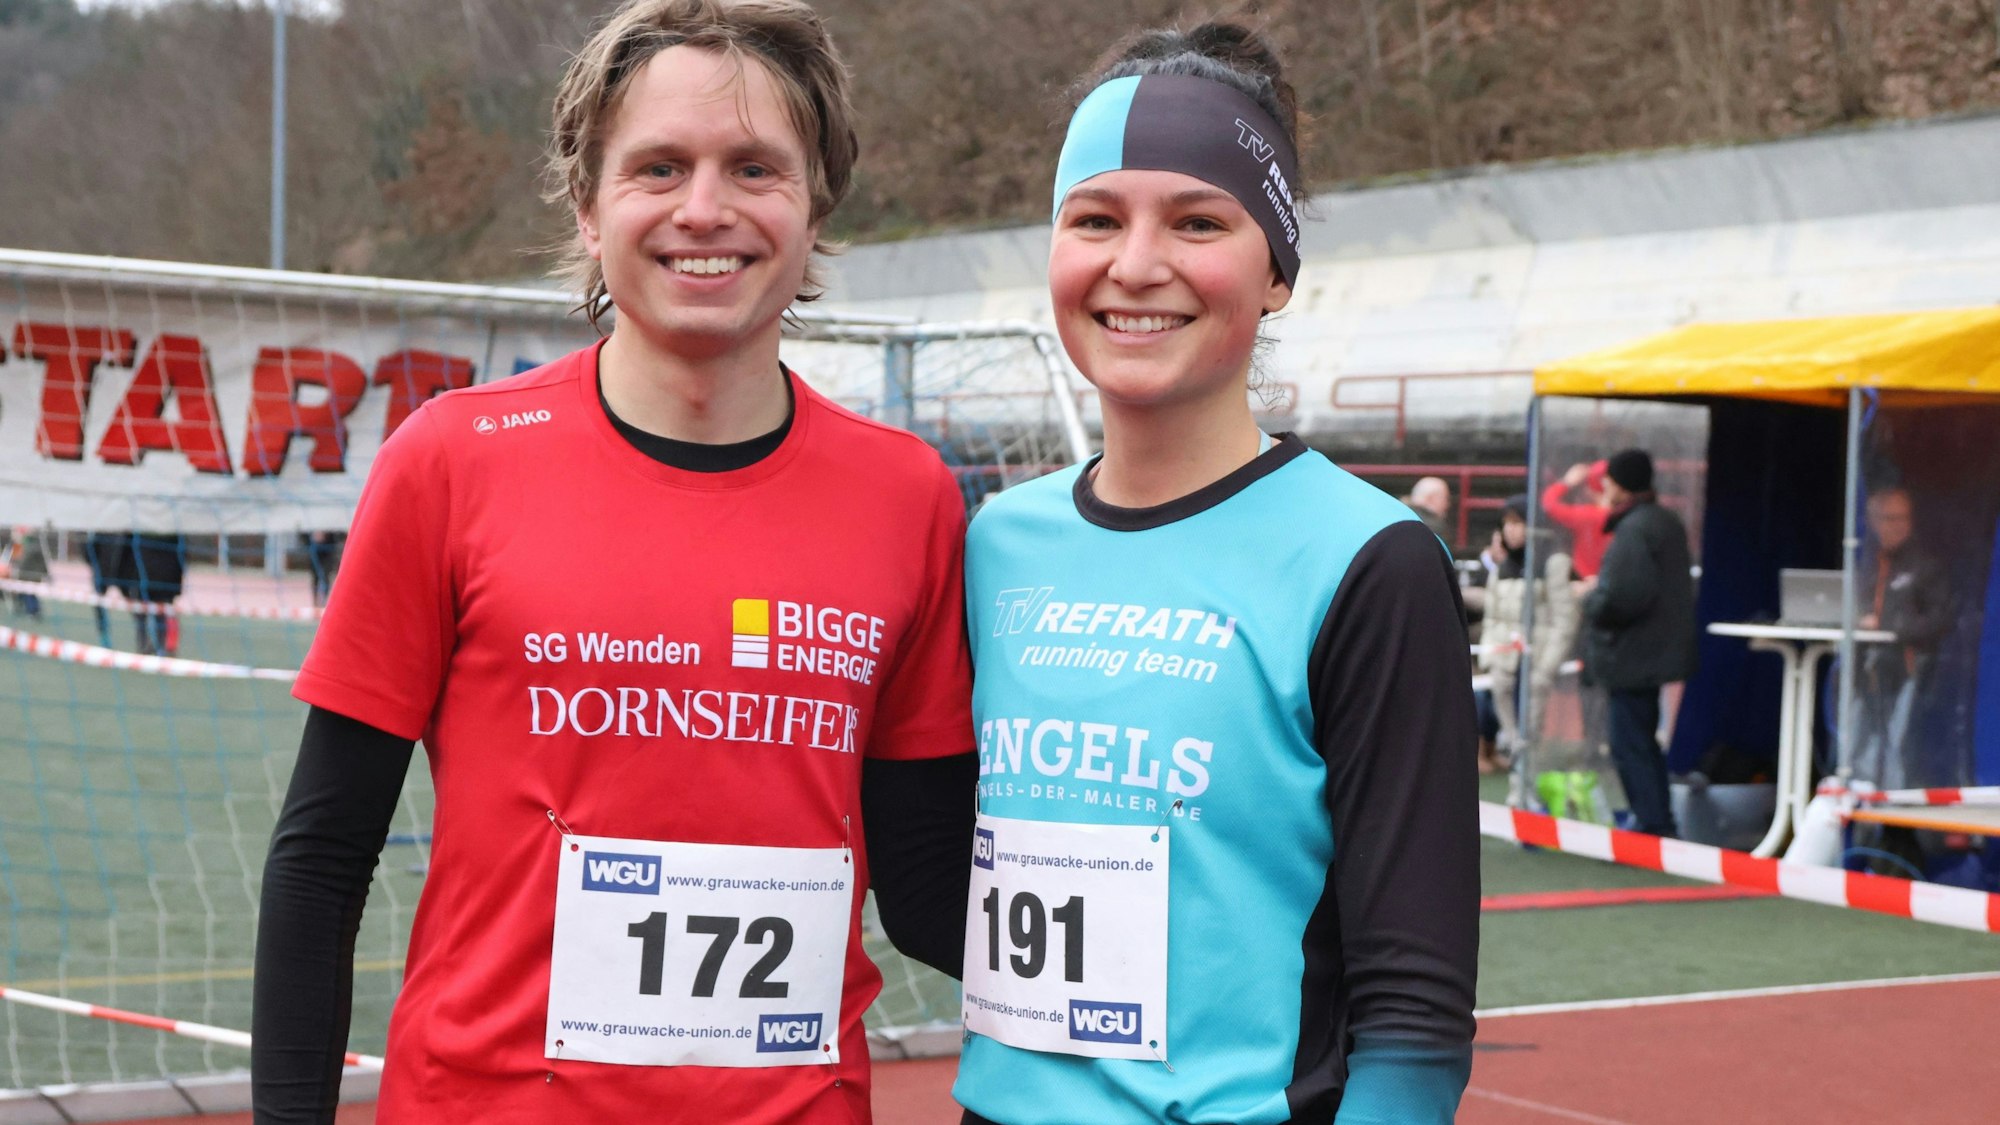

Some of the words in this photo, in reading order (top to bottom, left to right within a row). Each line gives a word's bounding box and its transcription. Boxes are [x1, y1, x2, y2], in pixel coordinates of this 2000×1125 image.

[1262, 179, 1297, 244] running
[0, 320, 476, 476] TART
[502, 409, 551, 429] JAKO
[777, 600, 885, 654] BIGGE
[1034, 602, 1237, 649] REFRATH
[524, 632, 567, 663] SG
[577, 632, 700, 665] Wenden
[777, 644, 877, 685] ENERGIE
[1019, 642, 1129, 677] running
[1134, 647, 1219, 684] team
[588, 859, 656, 886] WGU
[666, 874, 845, 892] www.grauwacke-union.de
[996, 850, 1153, 871] www.grauwacke-union.de
[627, 911, 794, 998] 172
[983, 887, 1084, 983] 191
[561, 1020, 752, 1039] www.grauwacke-union.de
[762, 1021, 819, 1044] WGU
[966, 993, 1064, 1023] www.grauwacke-union.de
[1073, 1007, 1137, 1035] WGU
